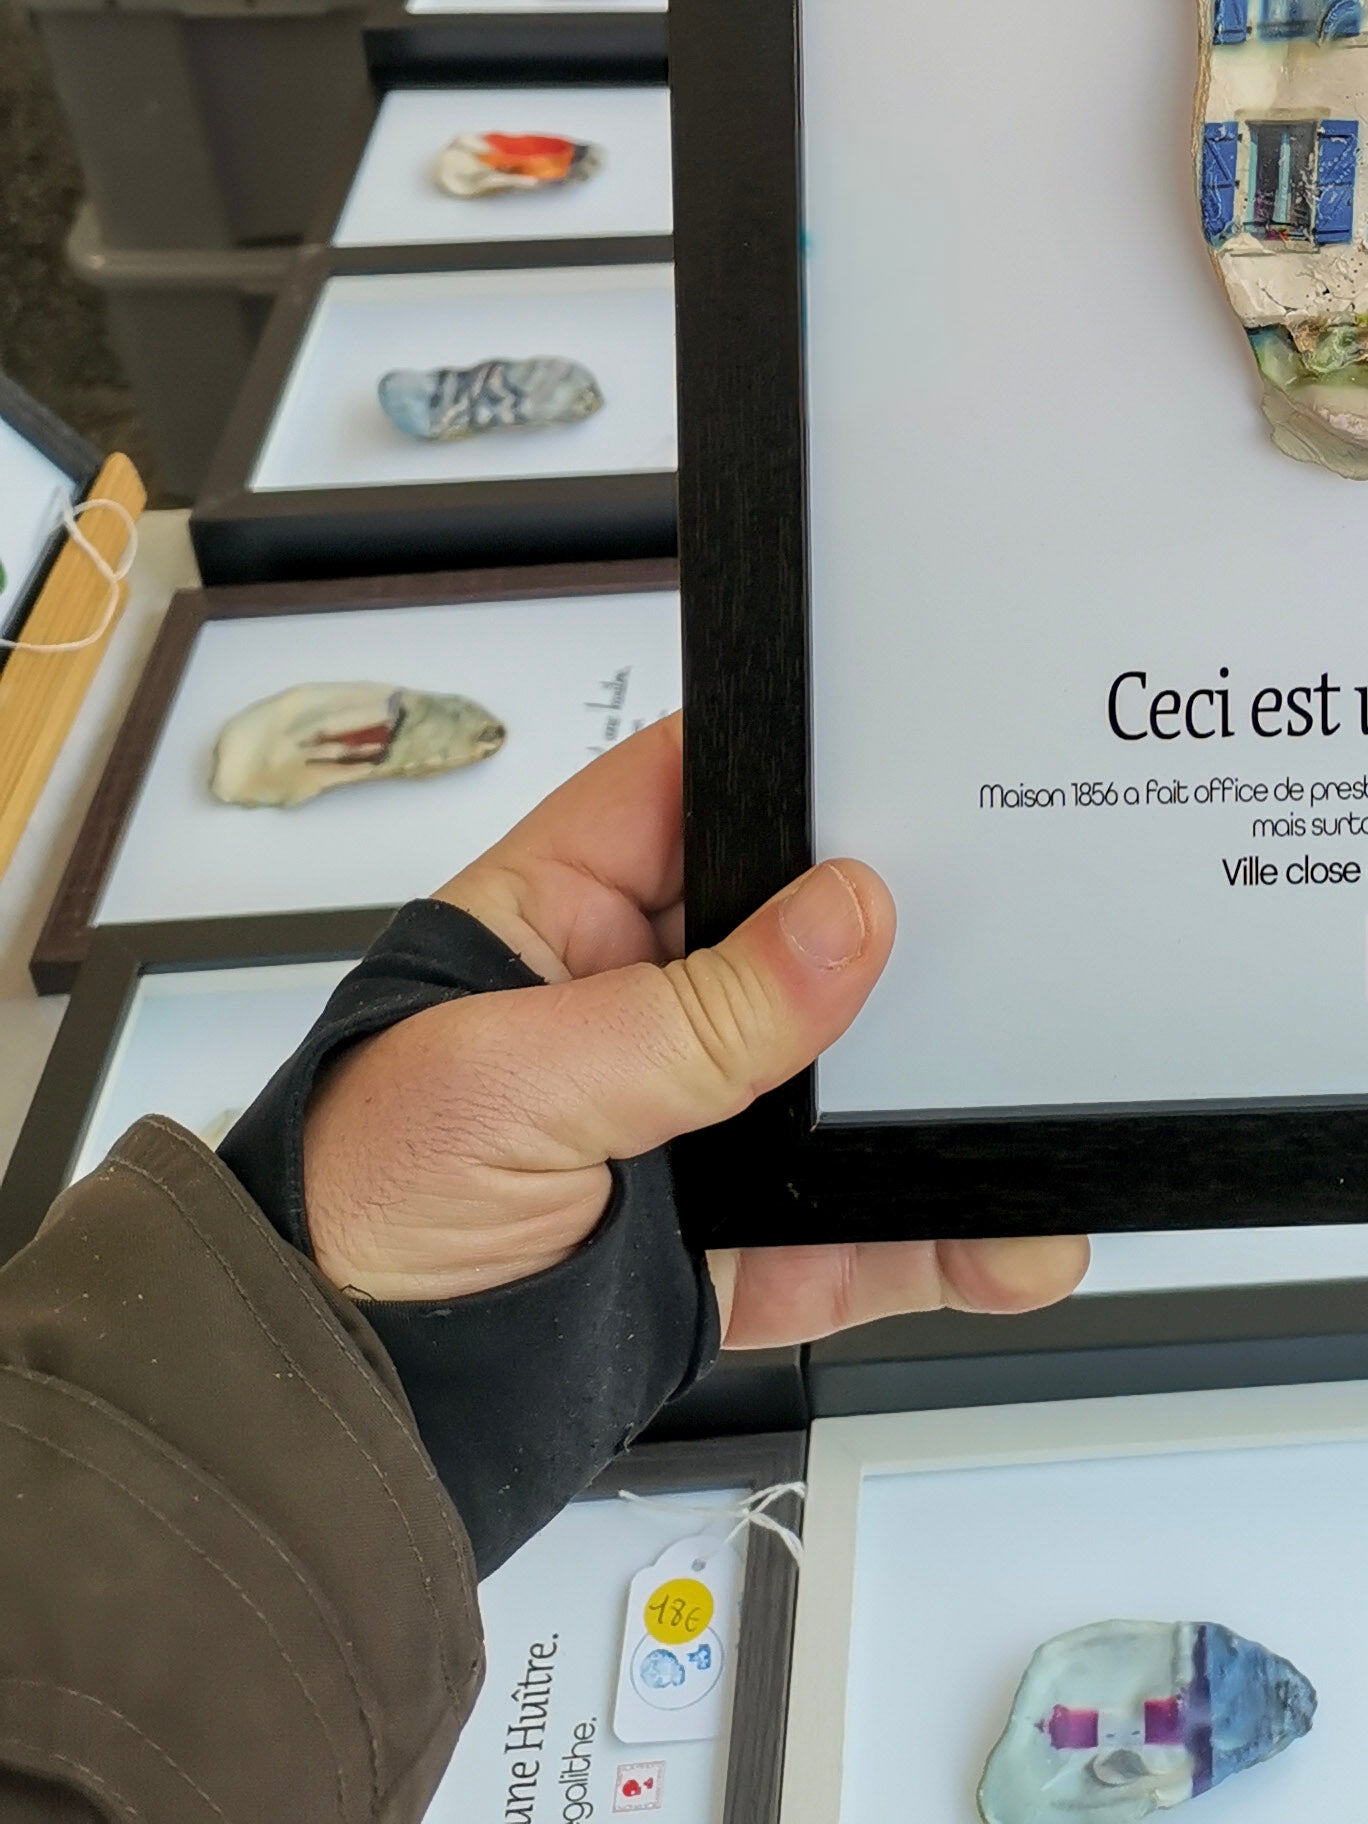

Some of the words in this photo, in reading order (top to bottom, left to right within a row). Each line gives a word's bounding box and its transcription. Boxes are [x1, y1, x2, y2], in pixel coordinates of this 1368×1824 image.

[1107, 666, 1236, 742] Ceci
[1250, 673, 1342, 738] est
[979, 782, 1066, 809] Maison
[1071, 781, 1119, 808] 1856
[1123, 784, 1140, 806] a
[1145, 778, 1190, 806] fait
[1193, 776, 1269, 804] office
[1273, 775, 1305, 802] de
[1252, 810, 1308, 838] mais
[1221, 855, 1280, 887] Ville
[1285, 853, 1362, 886] close
[503, 1632, 560, 1755] Huître.
[504, 1759, 541, 1824] une
[557, 1716, 598, 1824] galithe.
